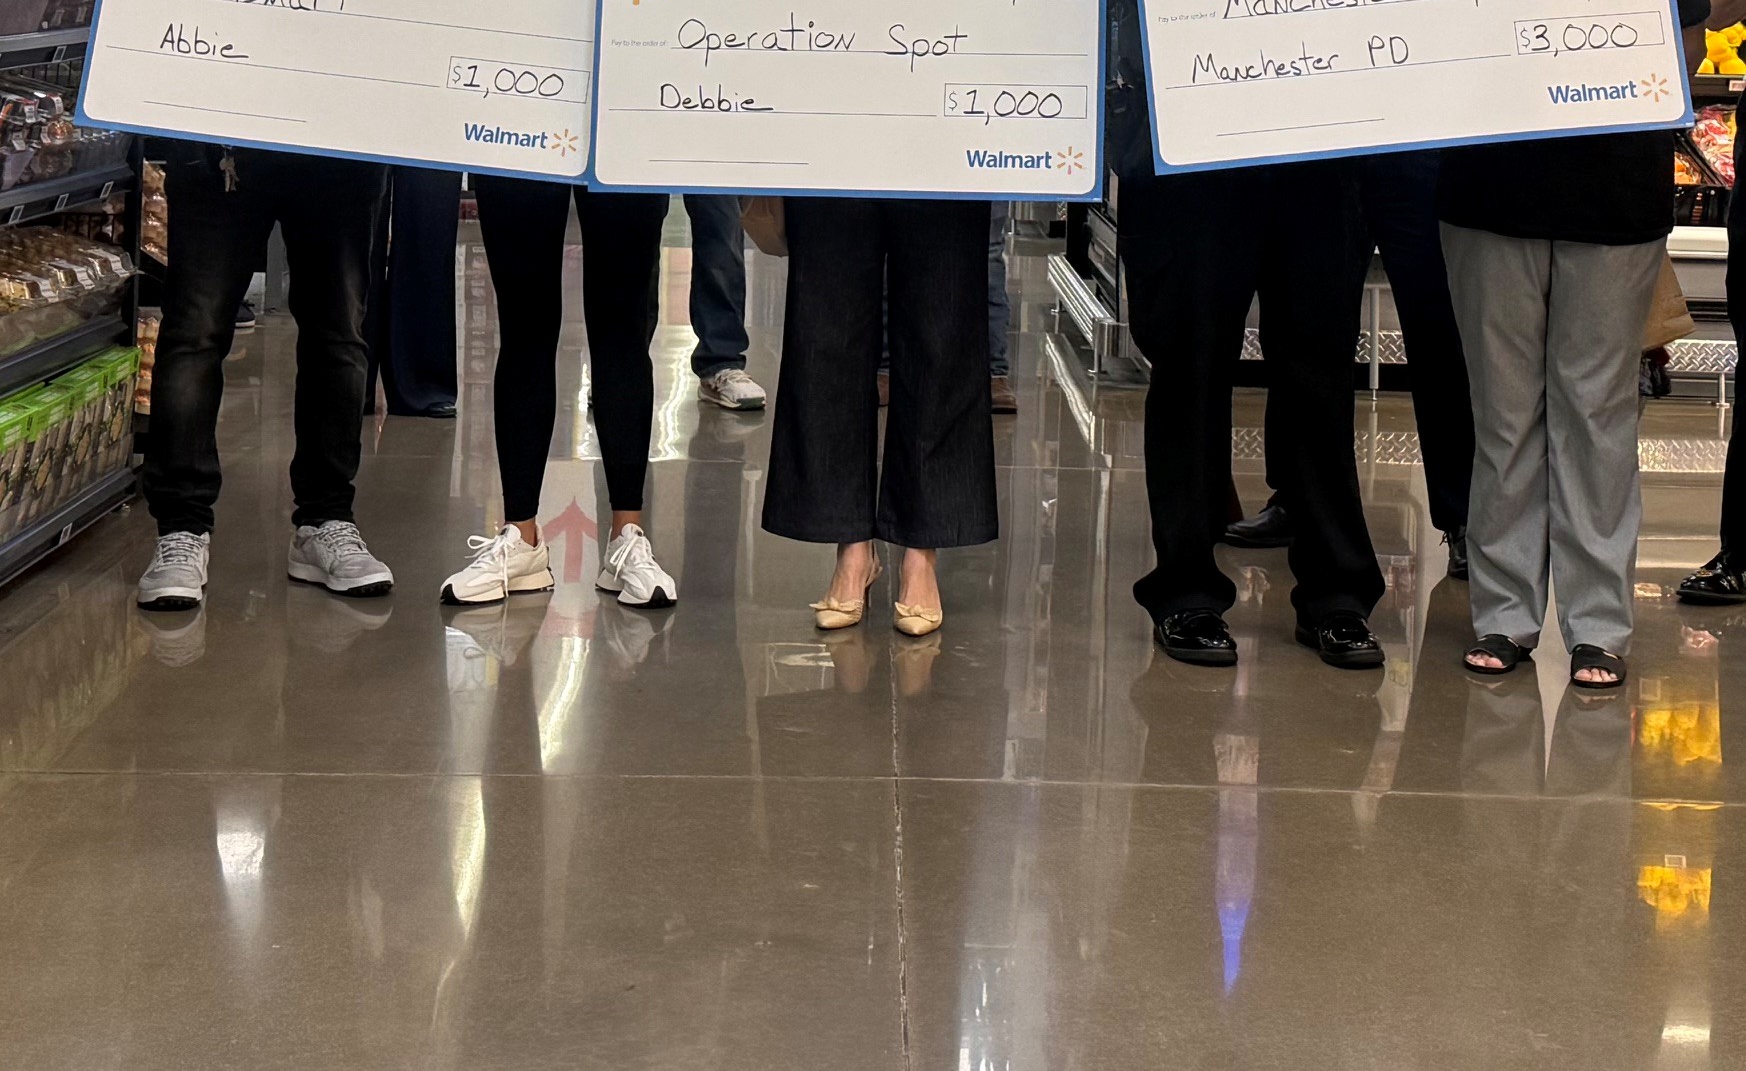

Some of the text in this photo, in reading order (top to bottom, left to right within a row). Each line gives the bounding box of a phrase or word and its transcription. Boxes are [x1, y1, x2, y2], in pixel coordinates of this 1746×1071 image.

[160, 23, 250, 59] Abbie
[677, 12, 968, 73] Operation Spot
[1367, 35, 1409, 67] PD
[660, 83, 774, 113] Debbie
[1547, 80, 1638, 104] Walmart
[463, 122, 548, 149] Walmart
[966, 149, 1052, 169] Walmart
